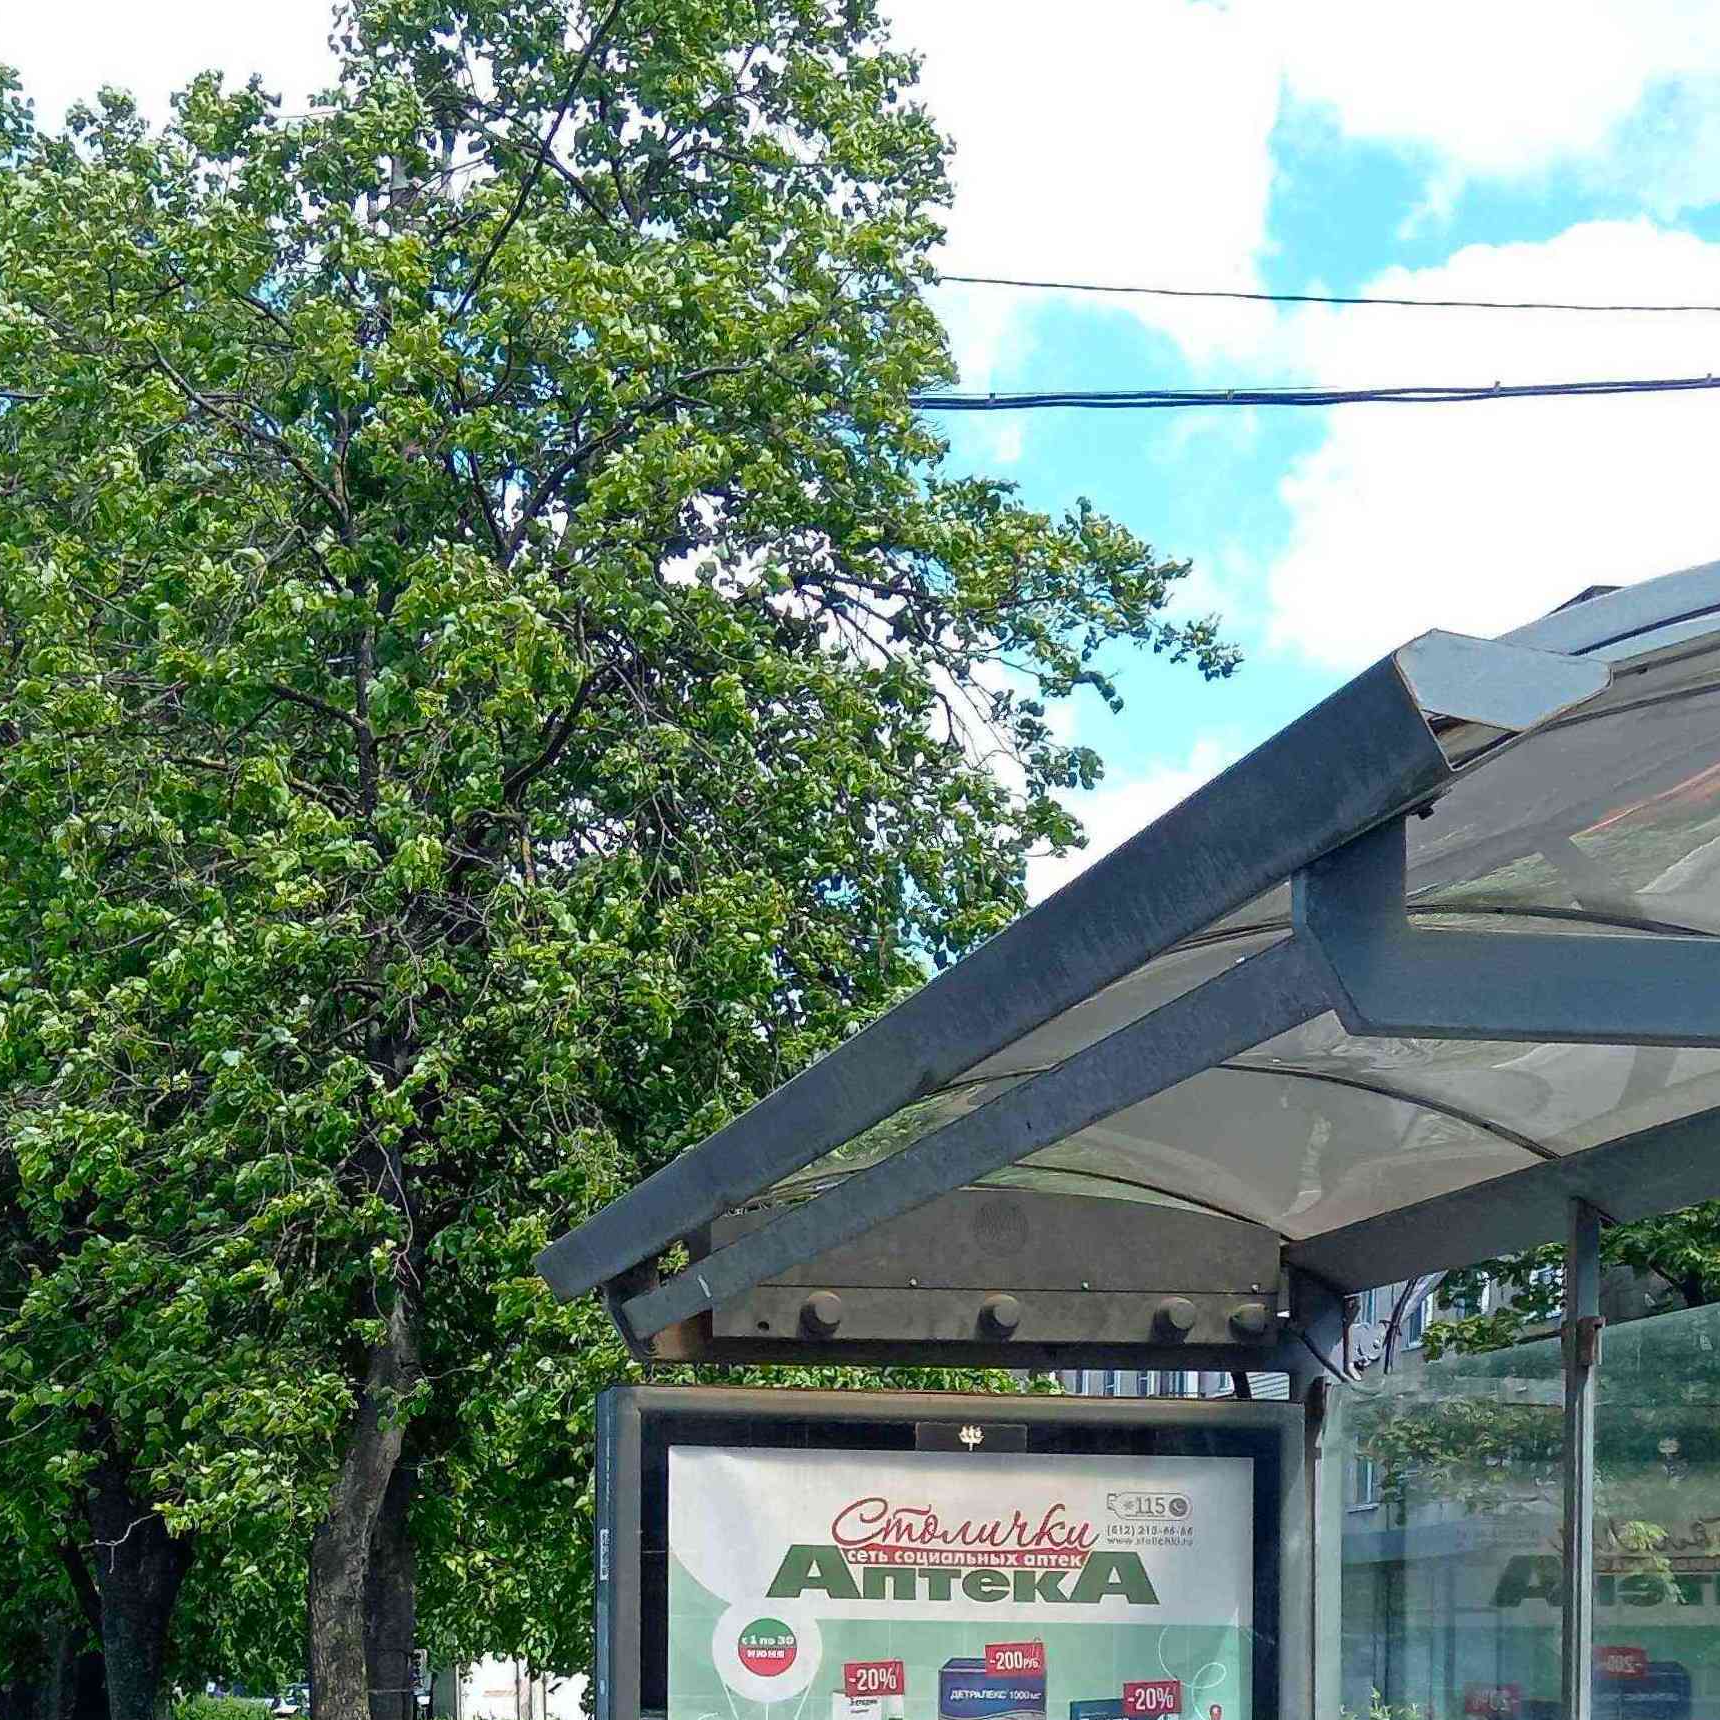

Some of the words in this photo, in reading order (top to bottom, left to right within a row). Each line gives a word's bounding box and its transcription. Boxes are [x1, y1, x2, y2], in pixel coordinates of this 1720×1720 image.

[831, 1497, 1100, 1549] Столички
[848, 1550, 889, 1564] сеть
[895, 1550, 1018, 1568] социальных
[1023, 1552, 1082, 1569] аптек
[759, 1637, 776, 1645] по
[777, 1635, 794, 1645] 30
[849, 1667, 897, 1691] -20%
[950, 1688, 1007, 1701] ДЕТРАЛЕКС
[1128, 1686, 1174, 1710] -20%
